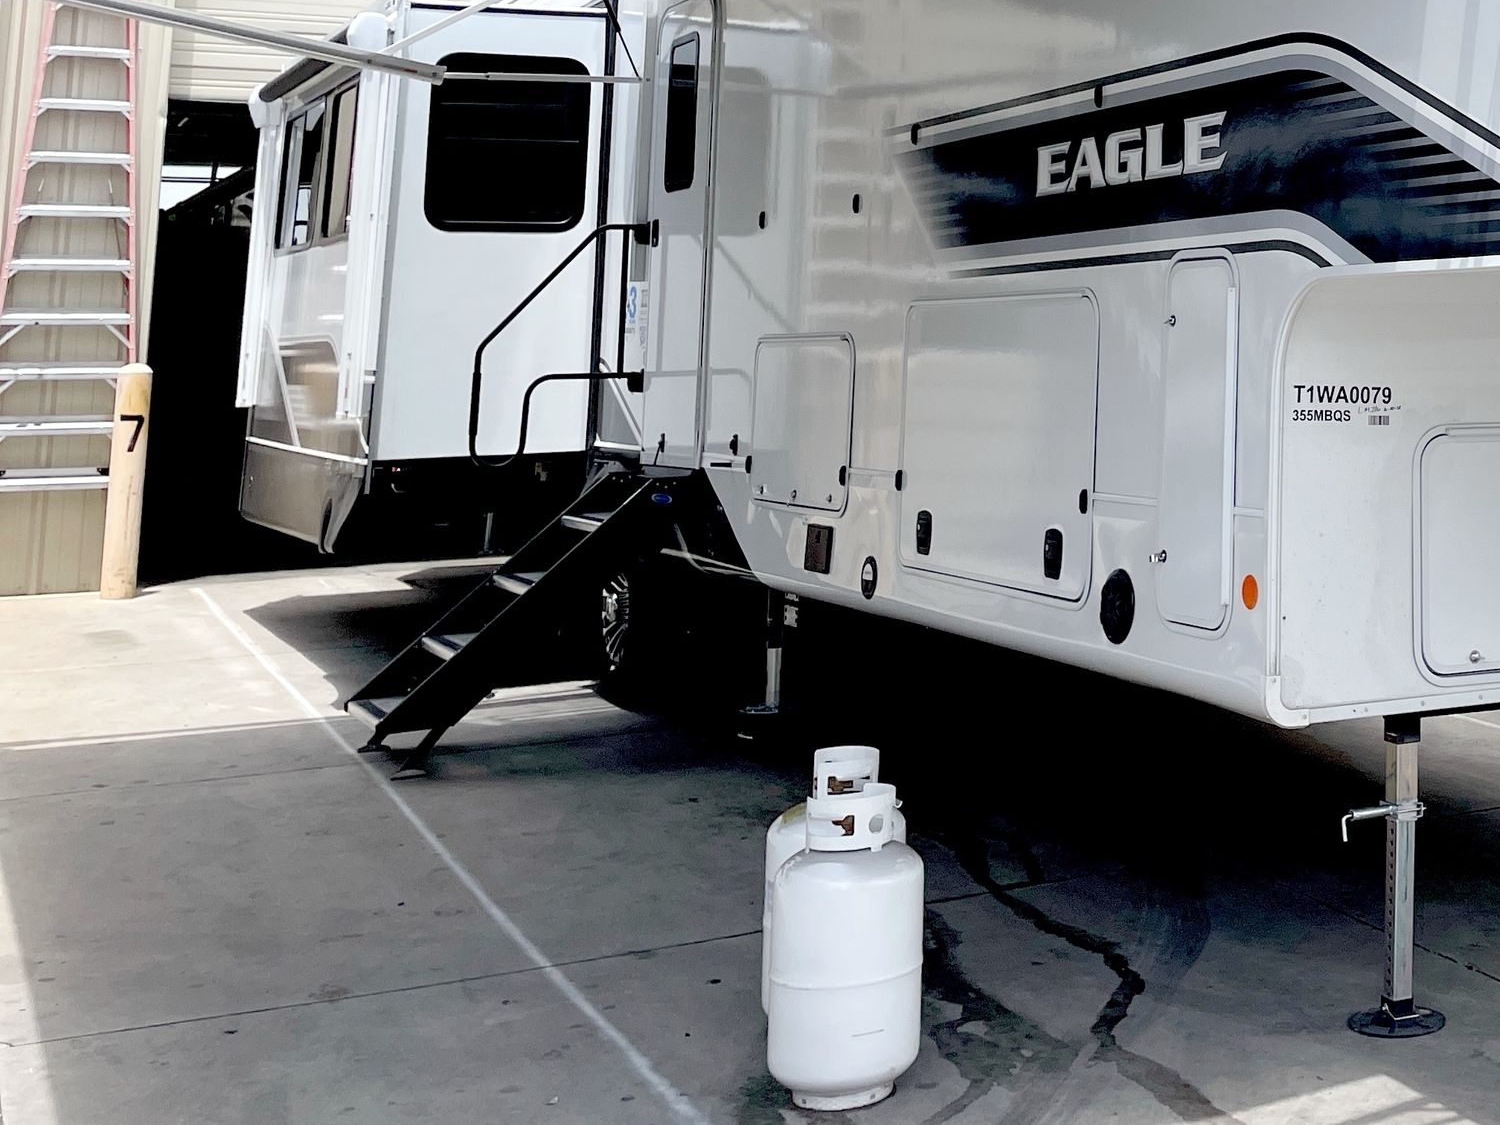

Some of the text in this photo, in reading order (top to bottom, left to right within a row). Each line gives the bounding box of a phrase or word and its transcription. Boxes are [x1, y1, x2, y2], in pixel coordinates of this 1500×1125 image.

[1035, 110, 1228, 197] EAGLE
[1293, 385, 1393, 405] T1WA0079
[1292, 409, 1351, 423] 355MBQS
[120, 414, 145, 453] 7
